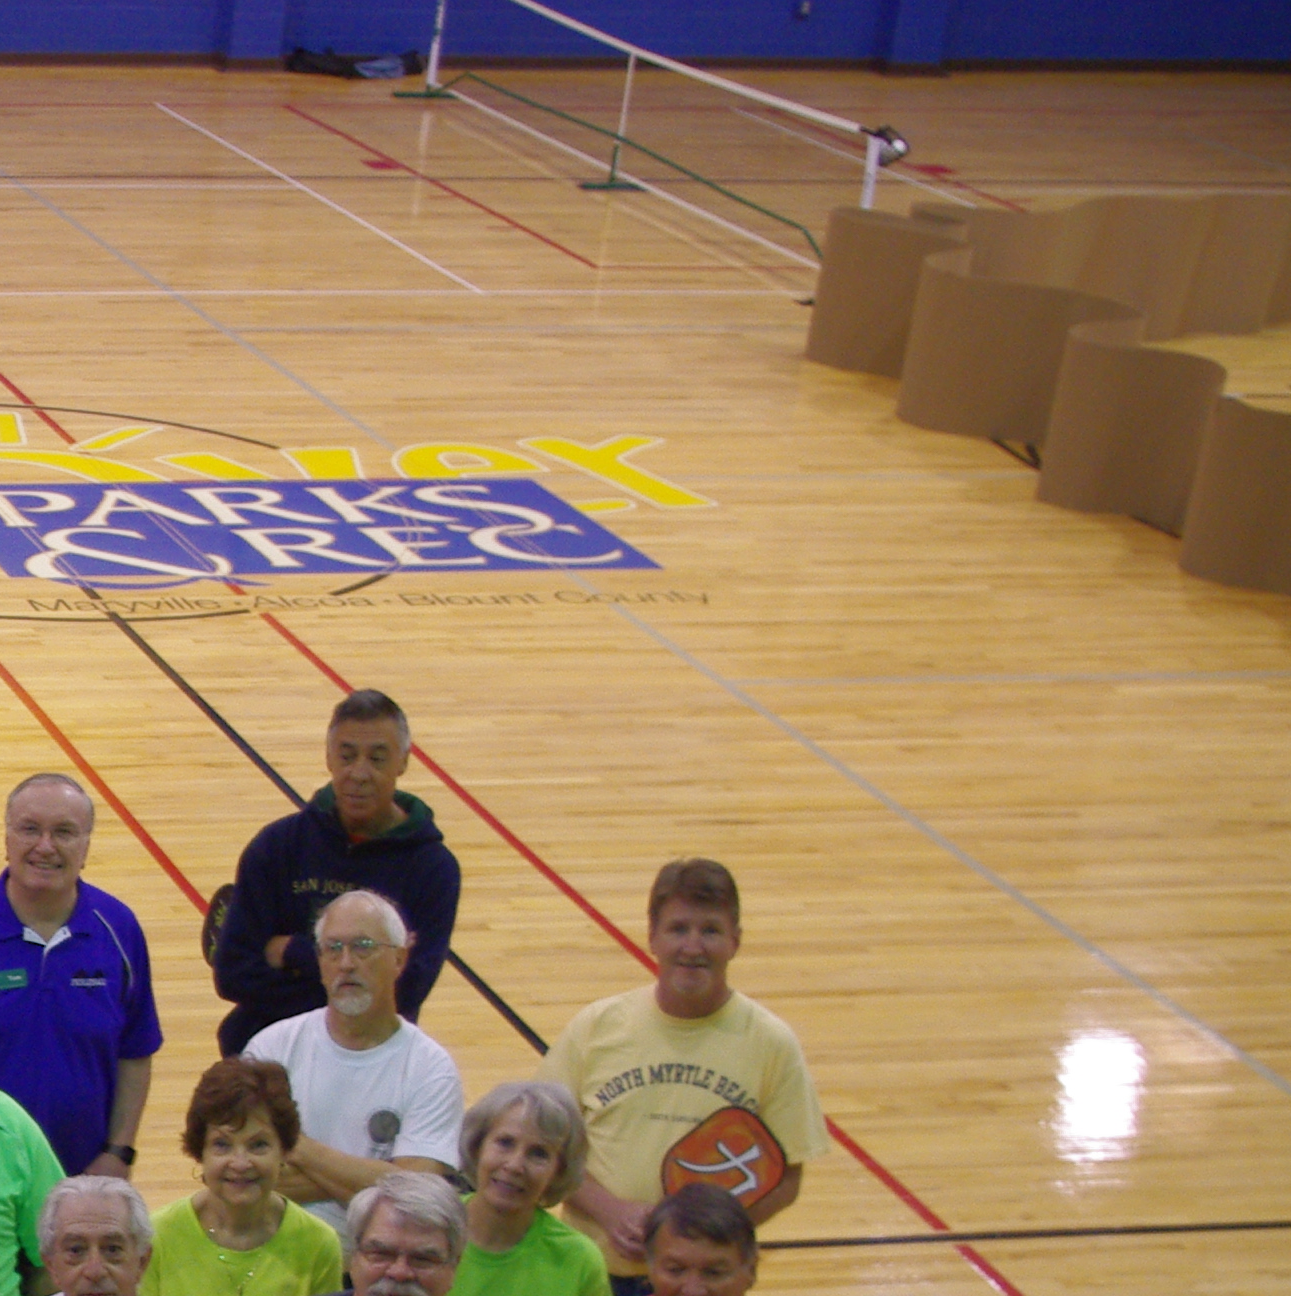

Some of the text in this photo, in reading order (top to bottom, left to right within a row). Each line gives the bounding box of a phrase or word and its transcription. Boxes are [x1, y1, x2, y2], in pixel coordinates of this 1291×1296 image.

[231, 525, 625, 569] REC
[26, 589, 710, 613] Maryville Alcoa Blount County
[292, 877, 319, 895] SAN
[595, 1062, 760, 1114] NORTH MYRTLE BEAC
